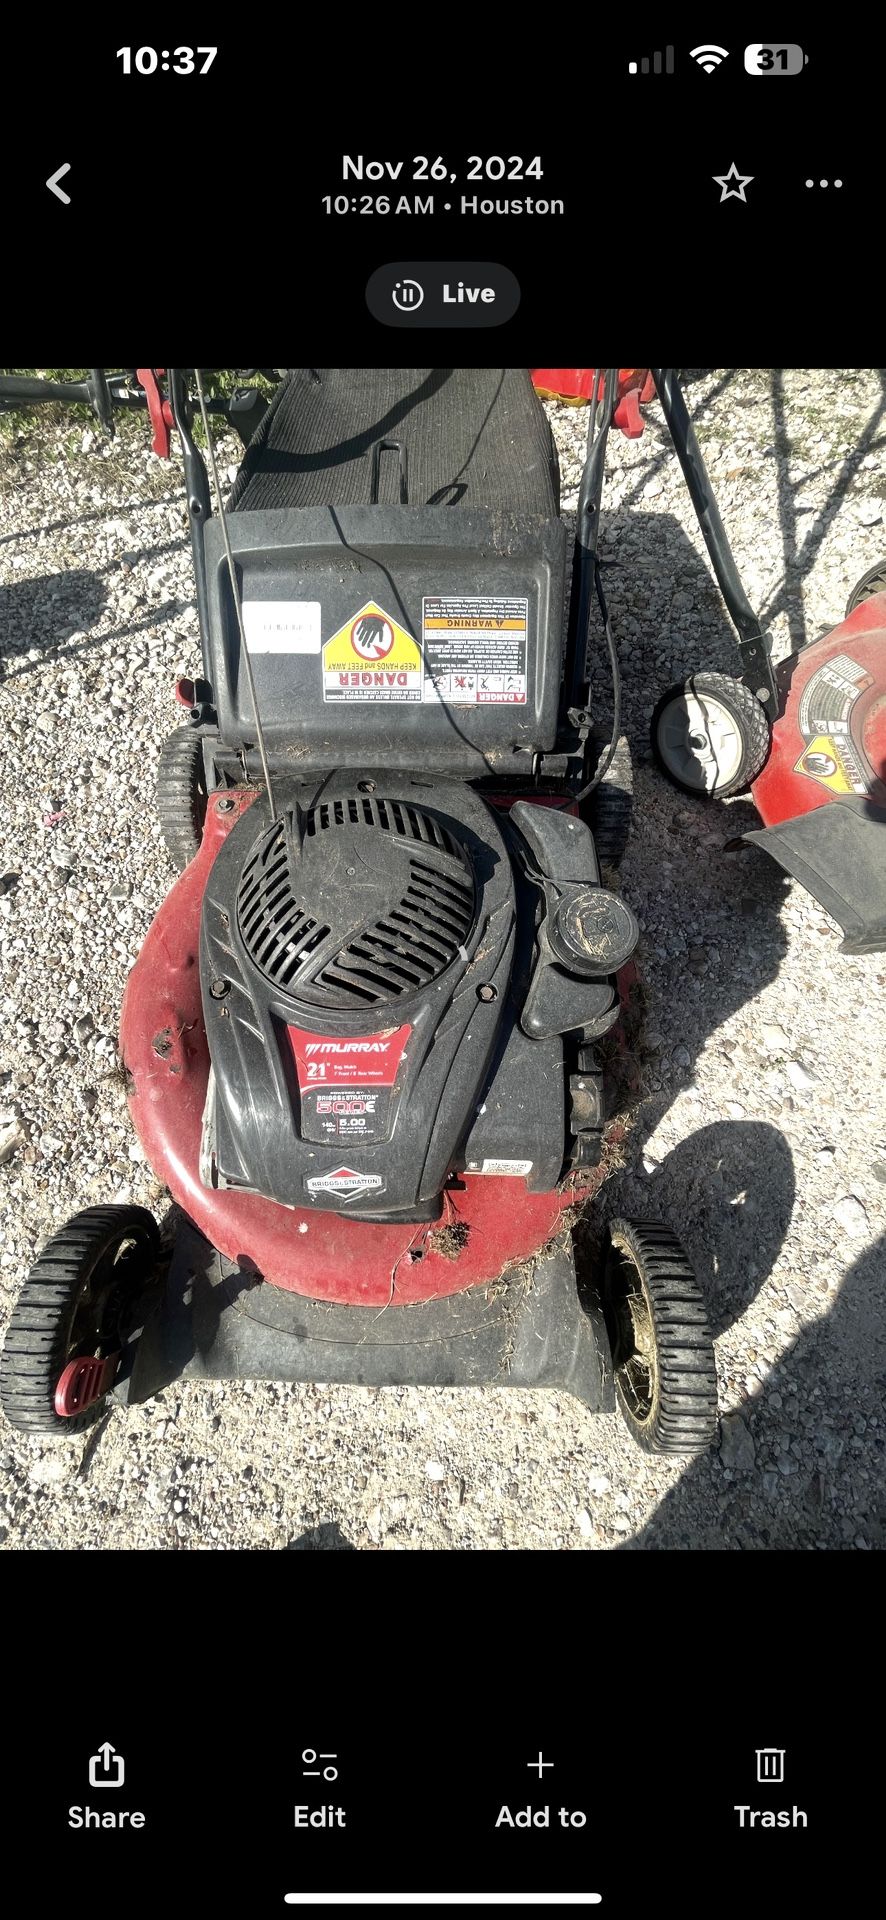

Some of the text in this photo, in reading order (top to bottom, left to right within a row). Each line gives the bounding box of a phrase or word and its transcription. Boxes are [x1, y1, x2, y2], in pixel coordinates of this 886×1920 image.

[339, 673, 407, 685] DANGER
[479, 693, 514, 701] DANGER
[836, 744, 861, 784] DANGER
[320, 1043, 391, 1052] MURRAY
